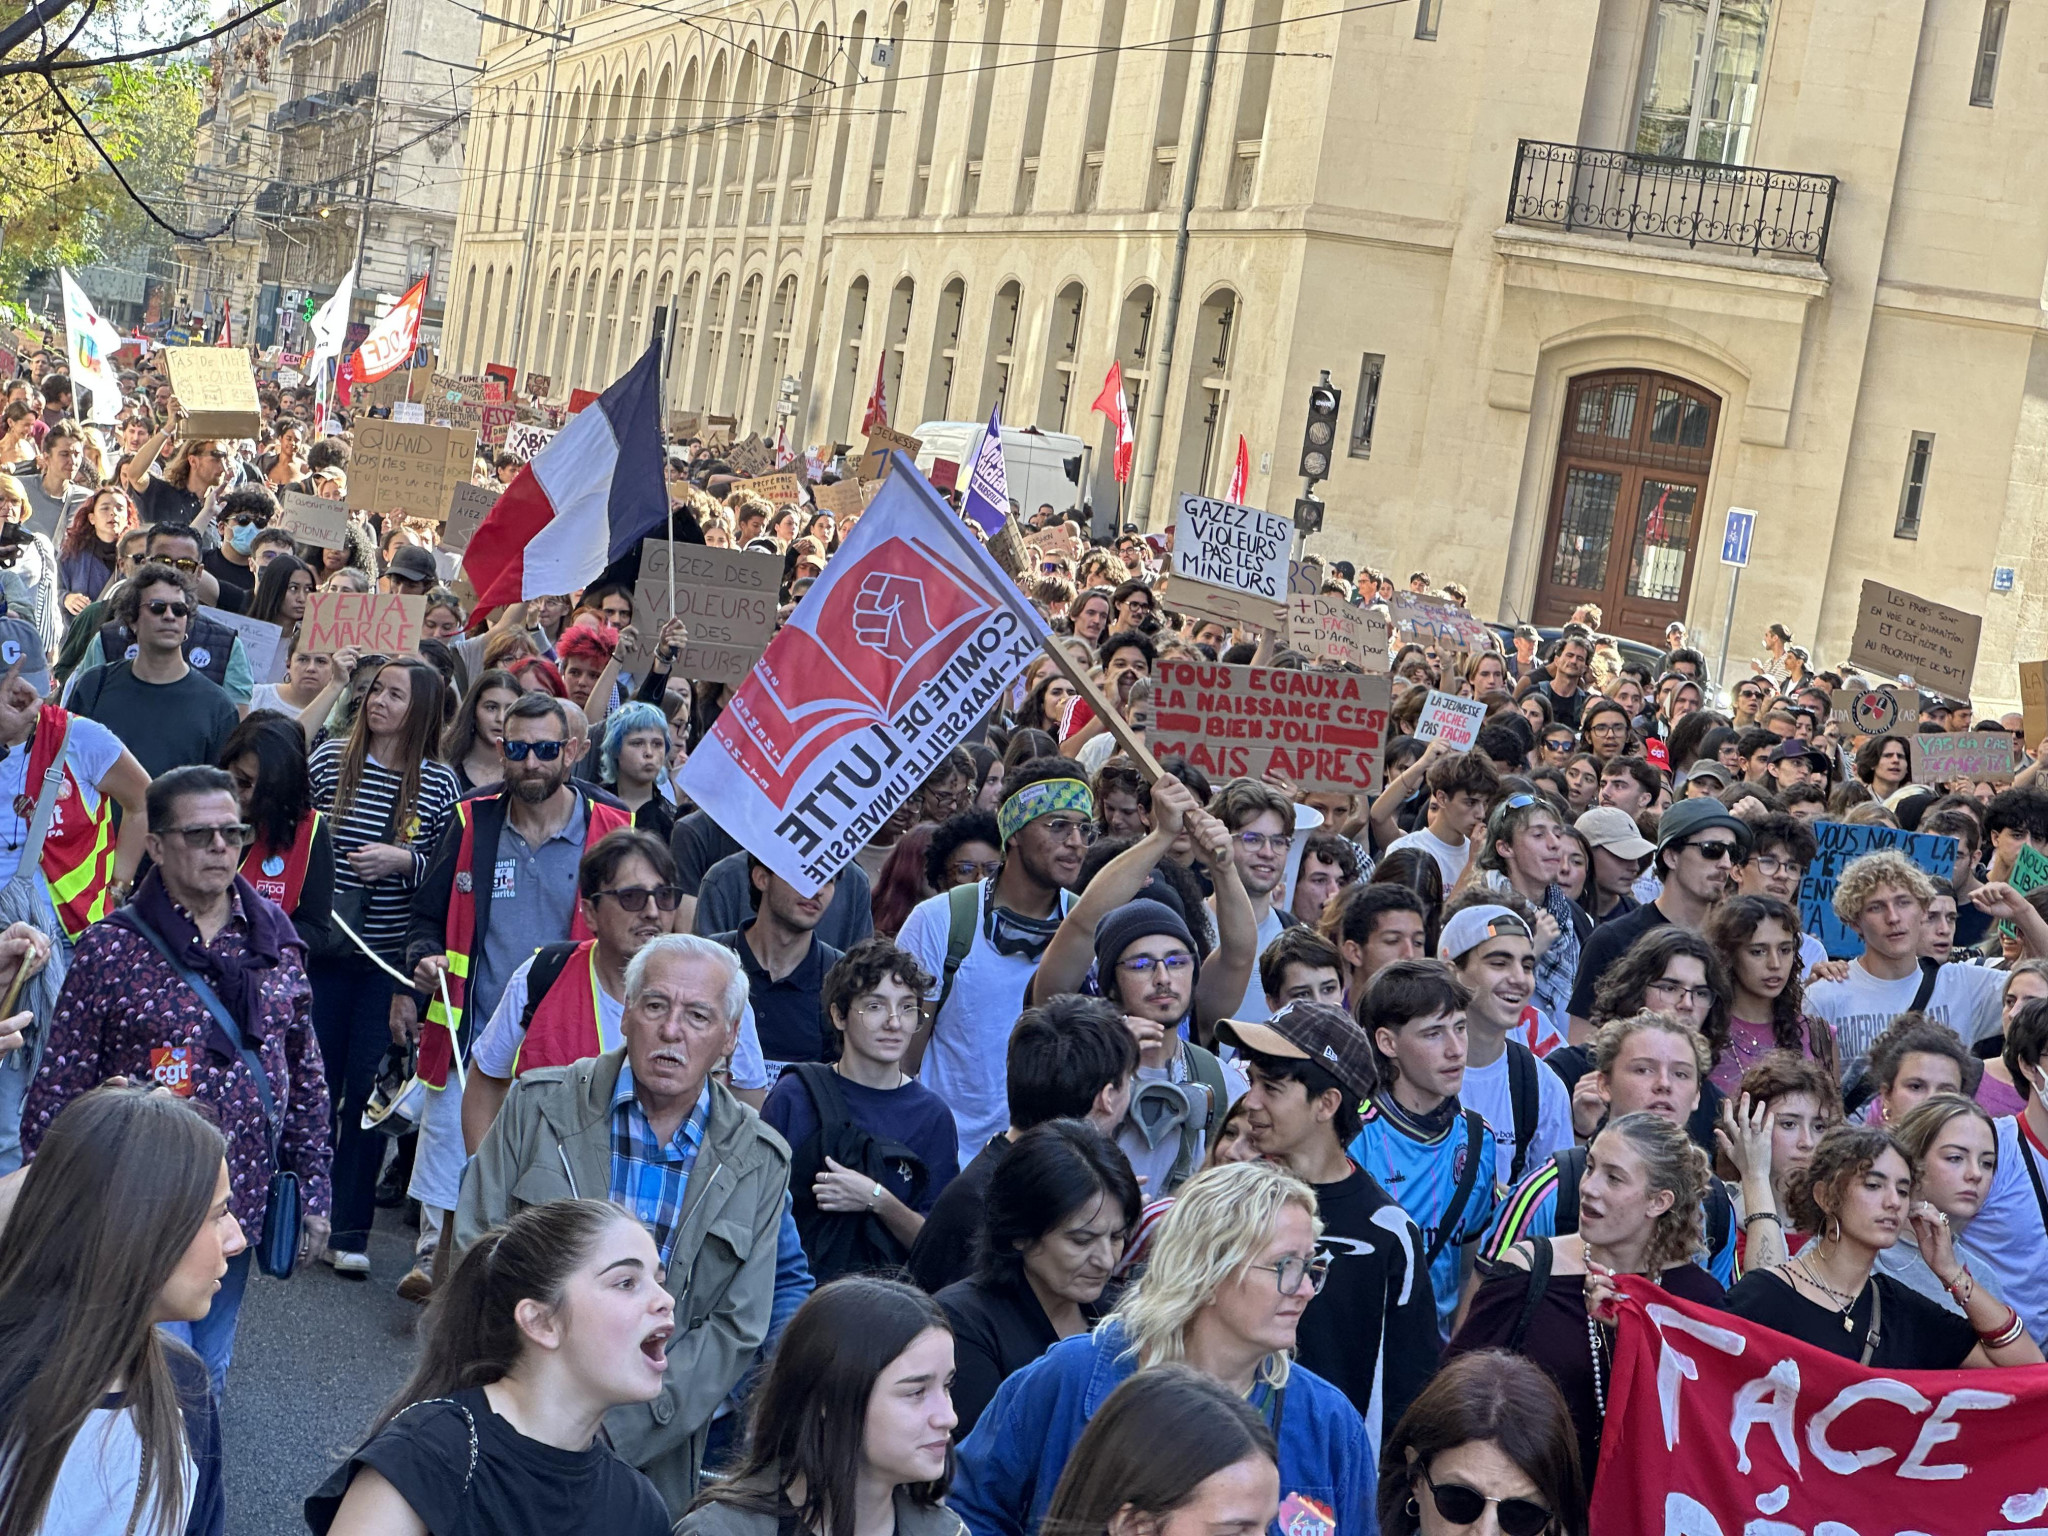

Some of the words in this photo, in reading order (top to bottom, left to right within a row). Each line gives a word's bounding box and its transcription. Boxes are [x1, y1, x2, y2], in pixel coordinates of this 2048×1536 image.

[879, 50, 886, 61] R
[360, 428, 432, 455] QUAND
[450, 441, 469, 459] TU
[875, 426, 920, 453] JEUNESSE
[353, 453, 378, 469] VOIS
[382, 457, 406, 471] MES
[352, 470, 370, 481] TU
[380, 474, 399, 485] VOIS
[405, 479, 417, 487] UN
[976, 482, 1003, 505] MARSEILLE
[457, 507, 480, 520] AVEZ
[1185, 499, 1248, 529] GAZEZ
[1256, 513, 1287, 541] LES
[648, 549, 713, 578] GAZEZ
[725, 564, 762, 586] DES
[1202, 541, 1232, 565] PAS
[1237, 551, 1264, 572] LES
[310, 594, 329, 621] Y
[380, 595, 408, 622] A
[1314, 600, 1337, 616] De
[1367, 620, 1386, 632] pour
[1870, 606, 1882, 616] EN
[1907, 617, 1917, 627] DE
[1888, 591, 1905, 607] LES
[1909, 601, 1932, 617] PROFS
[308, 622, 414, 651] MARRE
[695, 623, 732, 641] DES
[1880, 622, 1893, 636] ET
[1940, 646, 1953, 659] PAS
[1363, 645, 1384, 656] pour
[1865, 639, 1877, 651] AU
[1881, 643, 1927, 666] PROGRAMME
[1930, 661, 1941, 672] DE
[1156, 662, 1232, 690] TOUS
[1249, 669, 1339, 699] EGAUX
[1342, 678, 1361, 700] A
[2023, 672, 2042, 689] LA
[1154, 688, 1186, 708] LA
[1197, 691, 1331, 722] NAISSANCE
[1430, 696, 1442, 707] LA
[1442, 698, 1482, 718] JEUNESSE
[1206, 716, 1262, 738] BIEN
[1266, 719, 1322, 743] JOLI
[1421, 720, 1439, 736] PAS
[1440, 725, 1471, 744] FACHO
[1153, 741, 1250, 778] MAIS
[1265, 745, 1374, 788] APRES
[1651, 749, 1665, 759] cgt
[1815, 823, 1858, 850] VOUS
[1866, 827, 1921, 857] NOUS
[2020, 847, 2048, 881] NOUS
[154, 1061, 189, 1085] cgt
[1645, 1301, 2016, 1482] FACE
